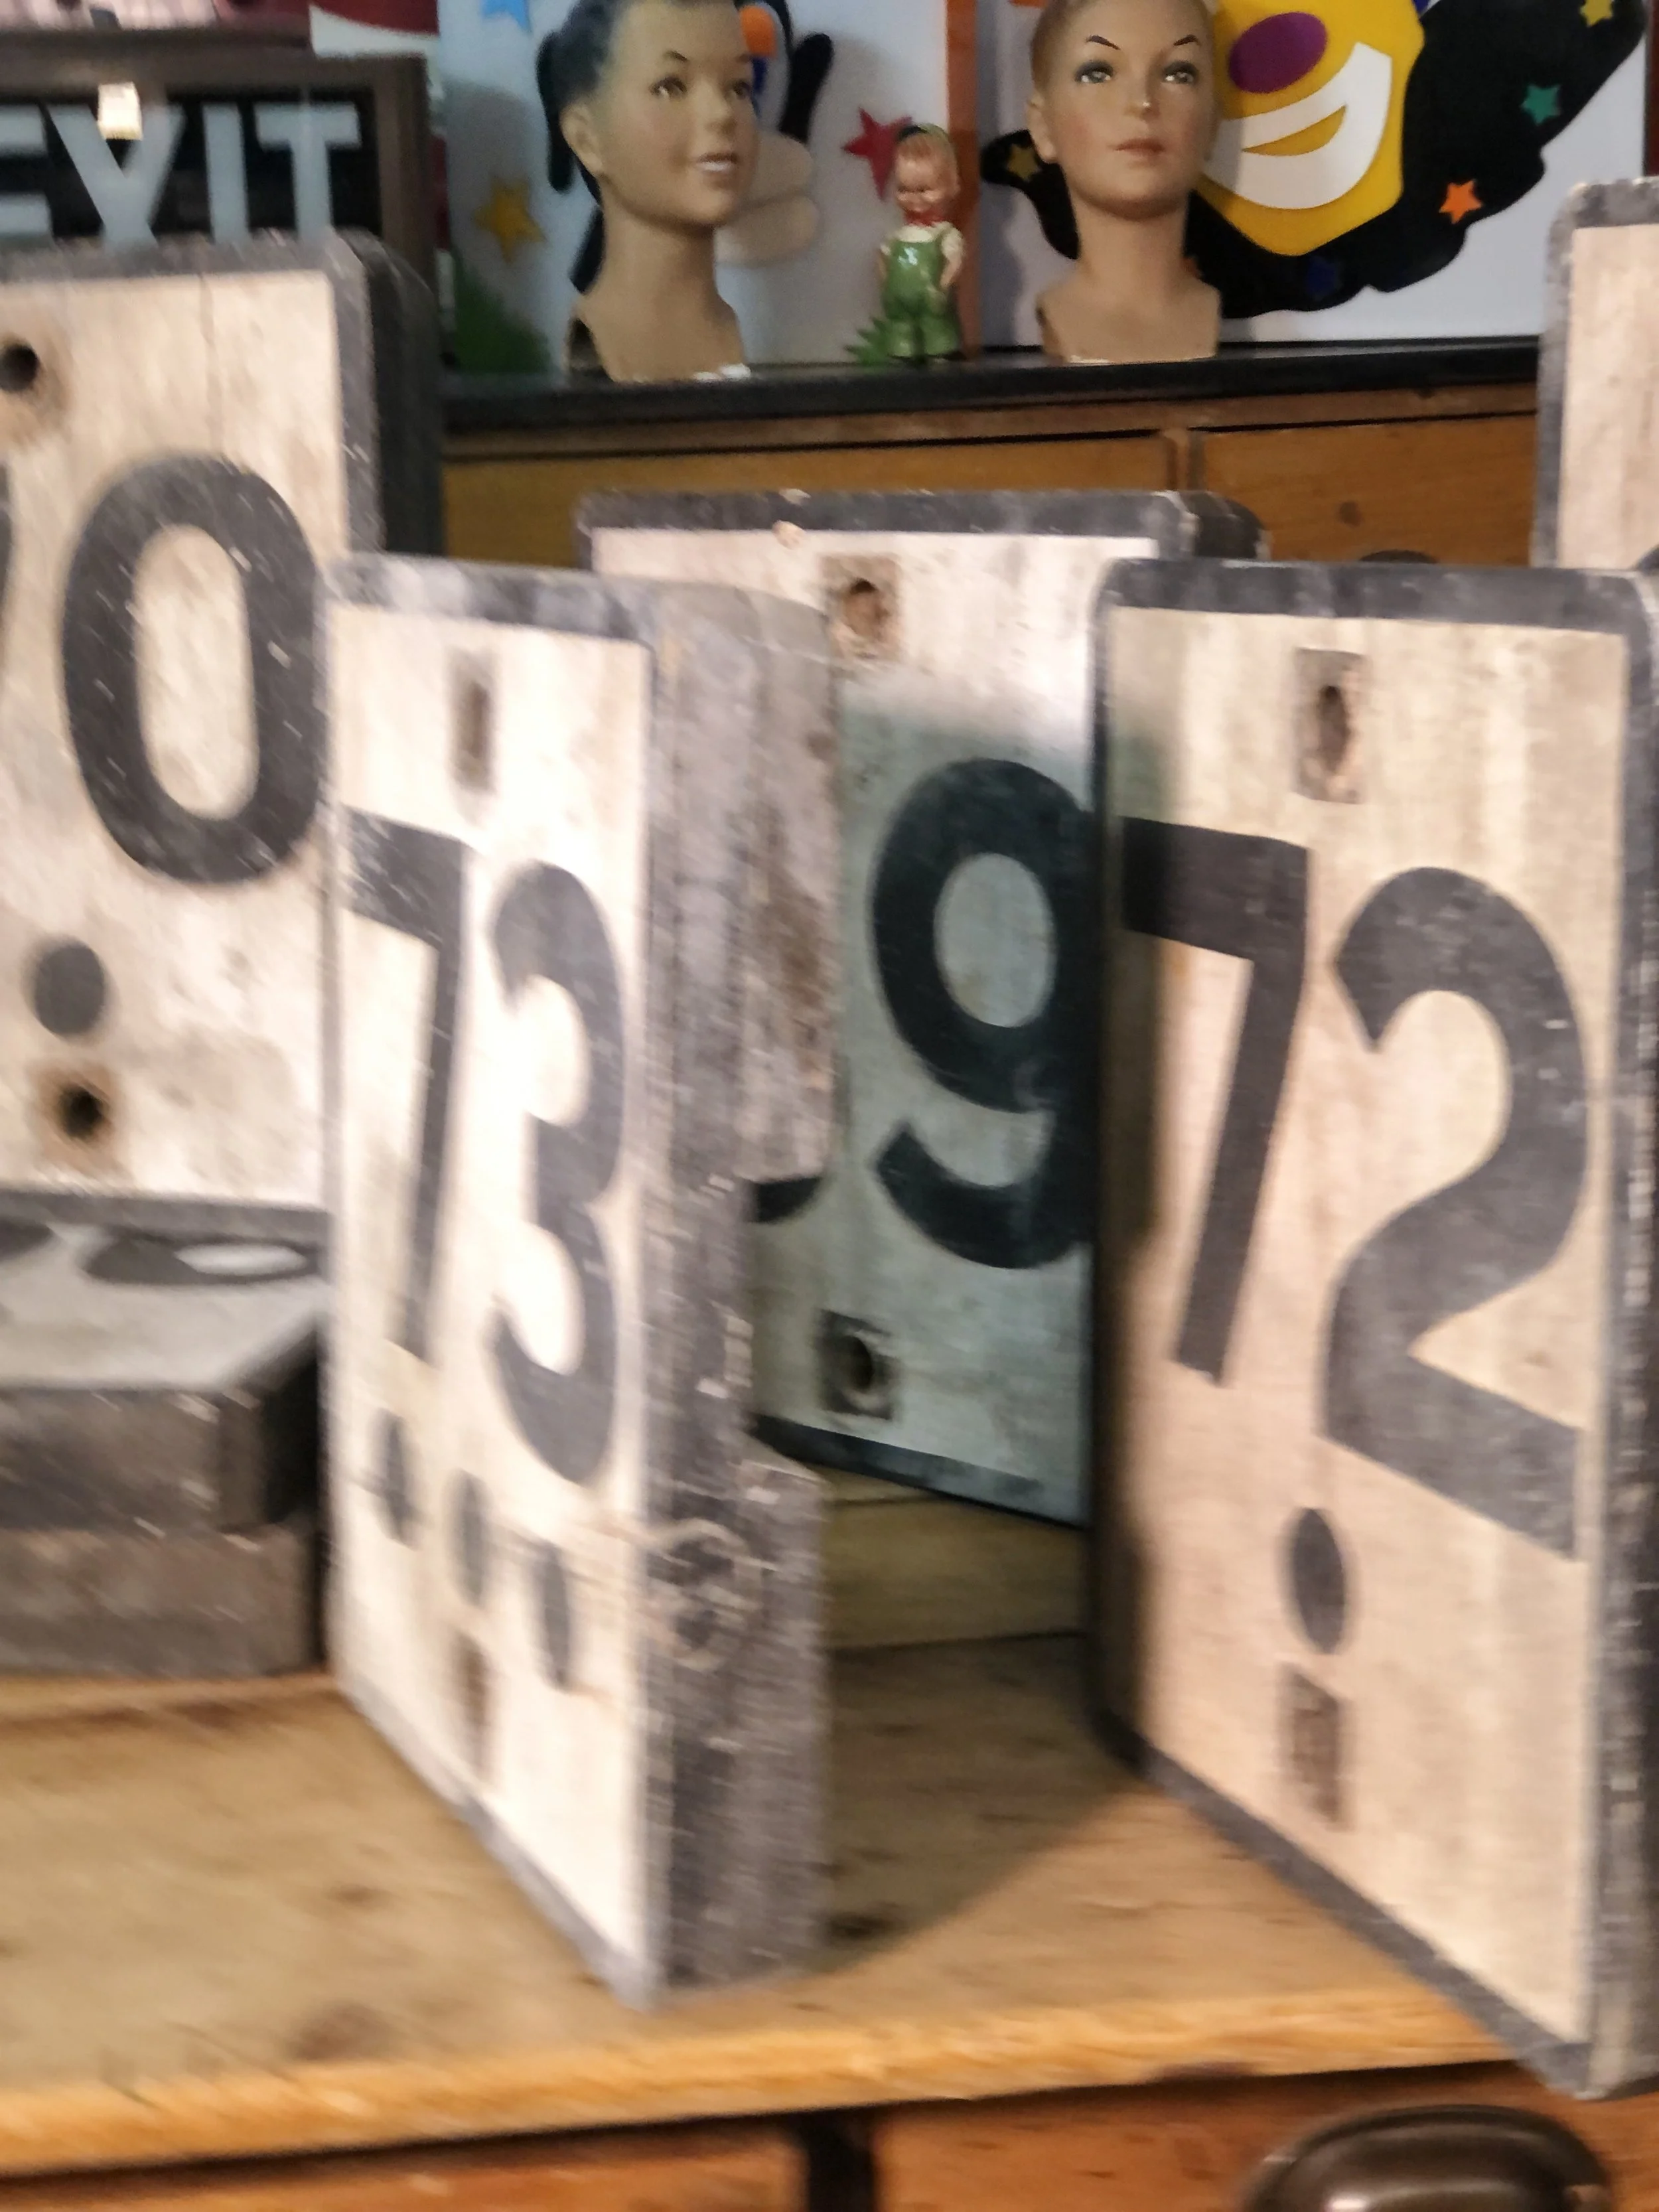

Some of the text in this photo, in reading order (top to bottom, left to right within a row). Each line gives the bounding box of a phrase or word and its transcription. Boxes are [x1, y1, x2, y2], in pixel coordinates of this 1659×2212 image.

[0, 451, 319, 886] 0
[337, 804, 625, 1487] 73
[742, 758, 1098, 1269] 9
[1116, 815, 1591, 1561] 72
